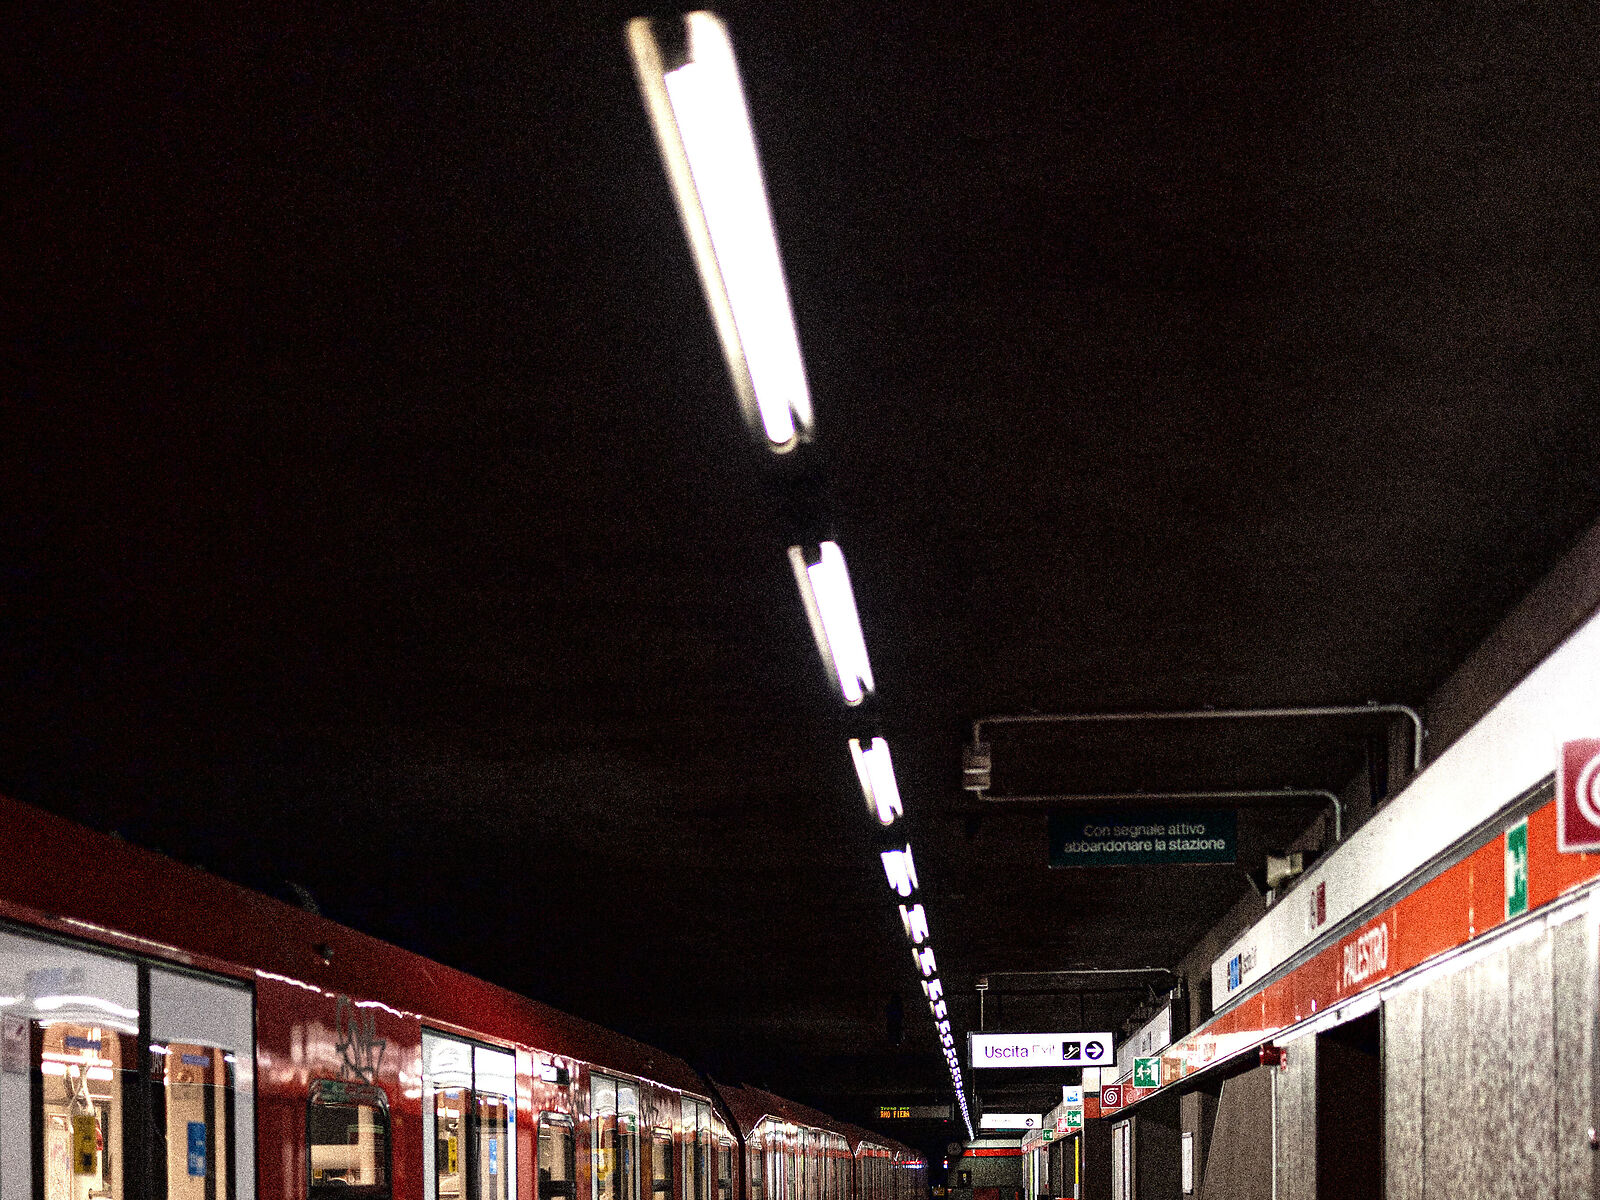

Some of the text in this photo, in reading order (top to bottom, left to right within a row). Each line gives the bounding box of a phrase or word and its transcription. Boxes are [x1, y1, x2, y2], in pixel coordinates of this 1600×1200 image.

[1083, 823, 1205, 838] Con segnale attivo
[1064, 838, 1226, 853] abbandonare la stazione
[1343, 922, 1388, 988] PALESTRO
[985, 1045, 1029, 1058] Uscita
